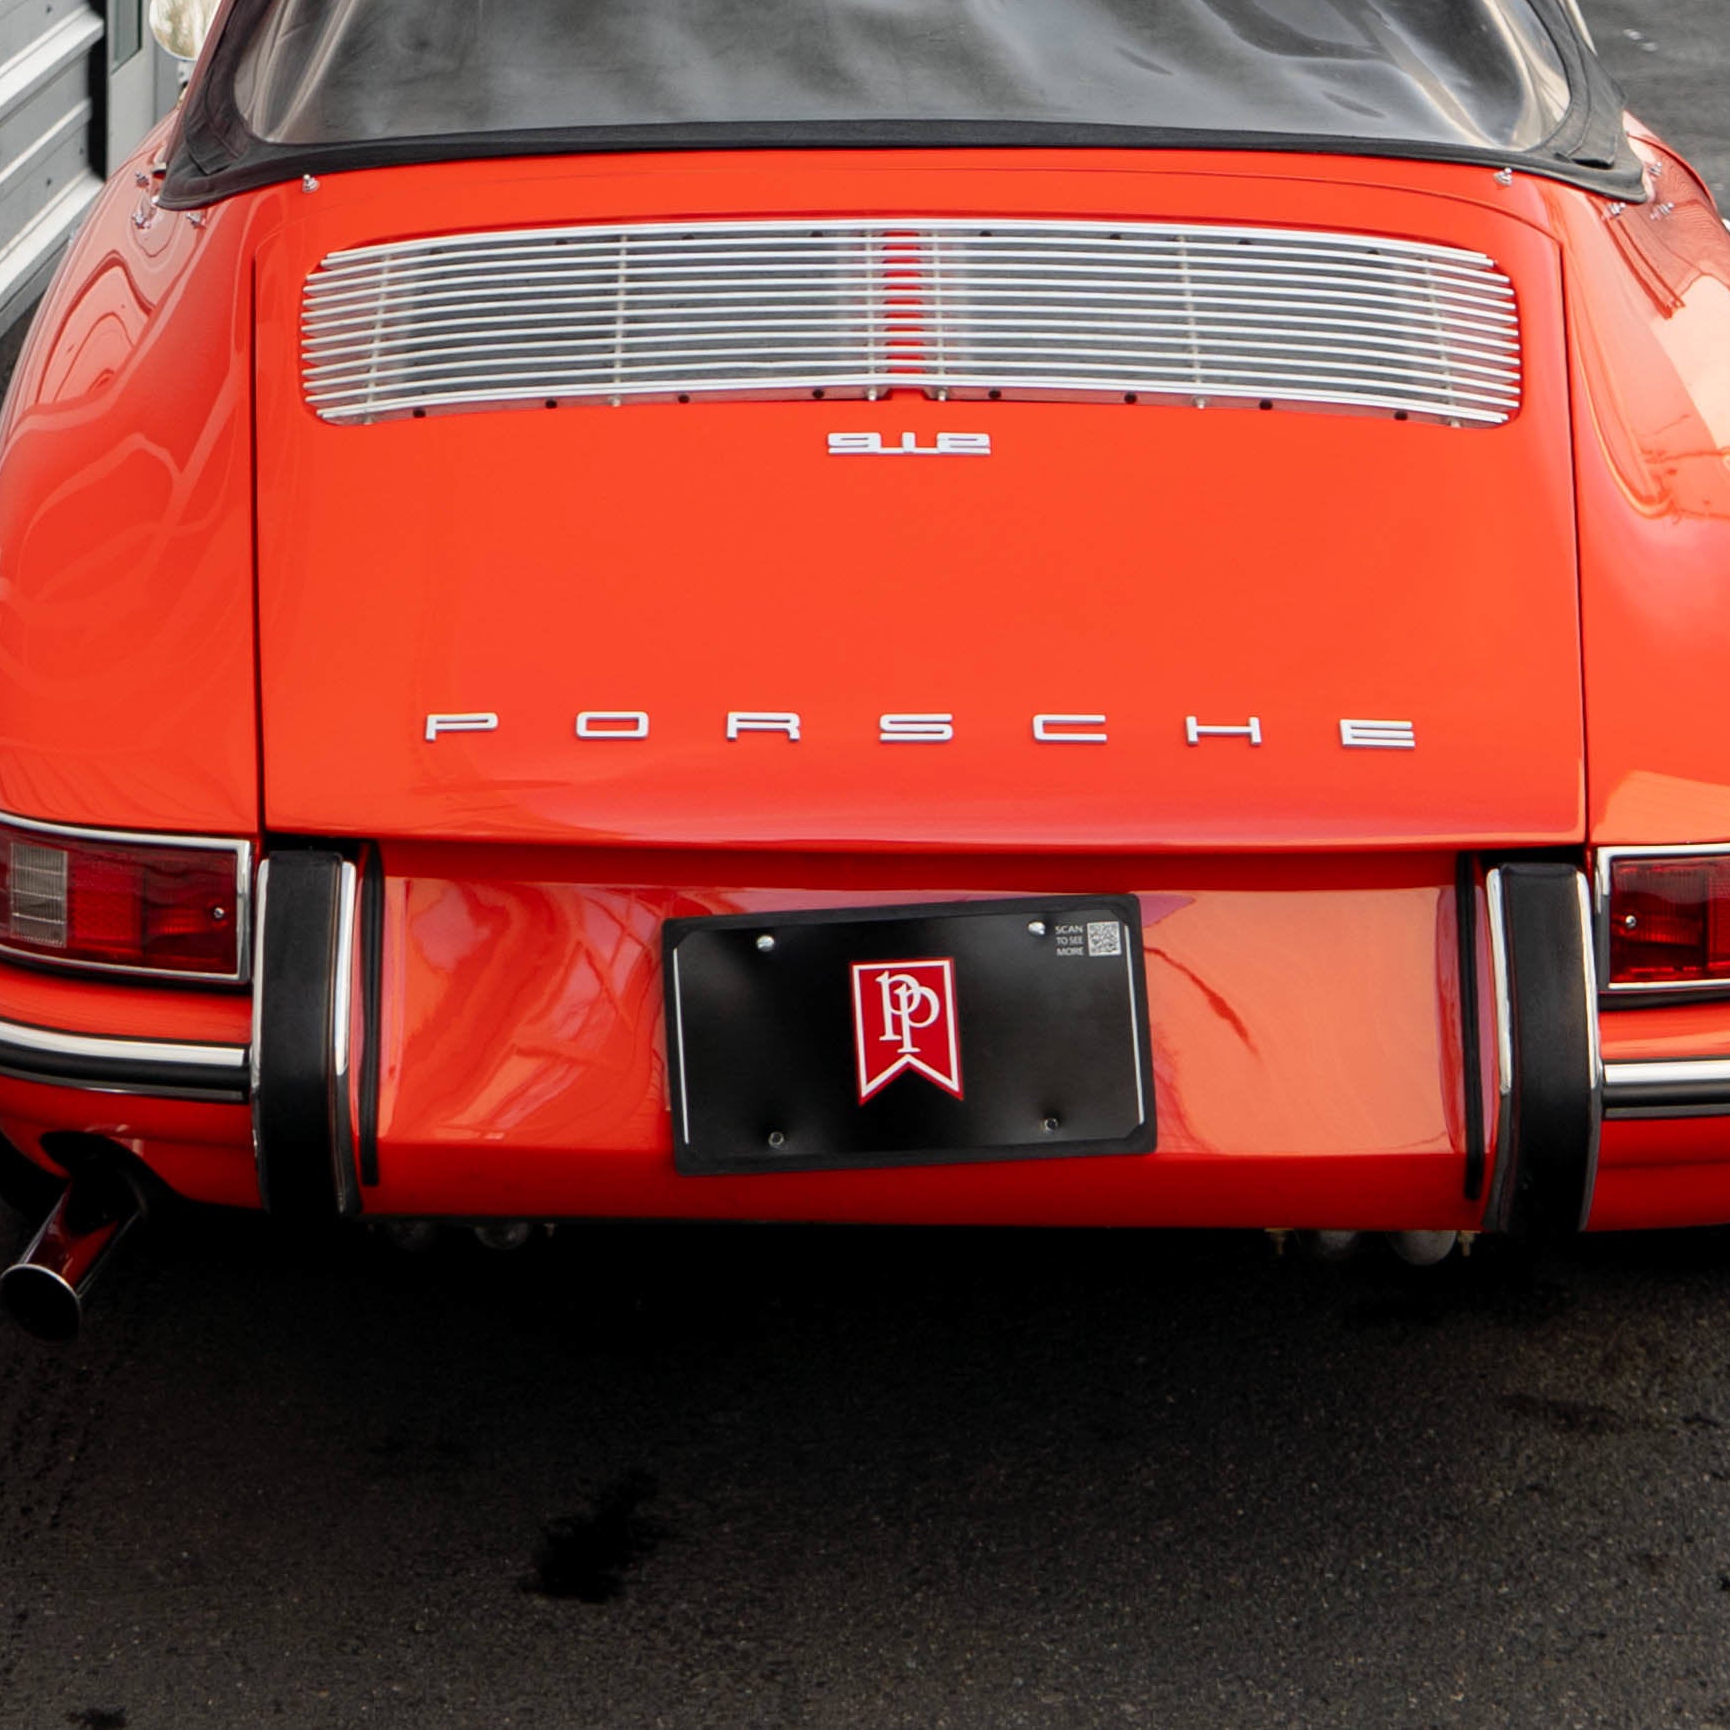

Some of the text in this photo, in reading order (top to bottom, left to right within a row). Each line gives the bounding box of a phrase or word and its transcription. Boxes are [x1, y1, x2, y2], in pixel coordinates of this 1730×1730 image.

[827, 431, 992, 455] 912
[425, 710, 1416, 749] PORSCHE
[1054, 924, 1084, 935] SCAN
[1055, 936, 1069, 946] TO
[1055, 946, 1085, 956] MORE
